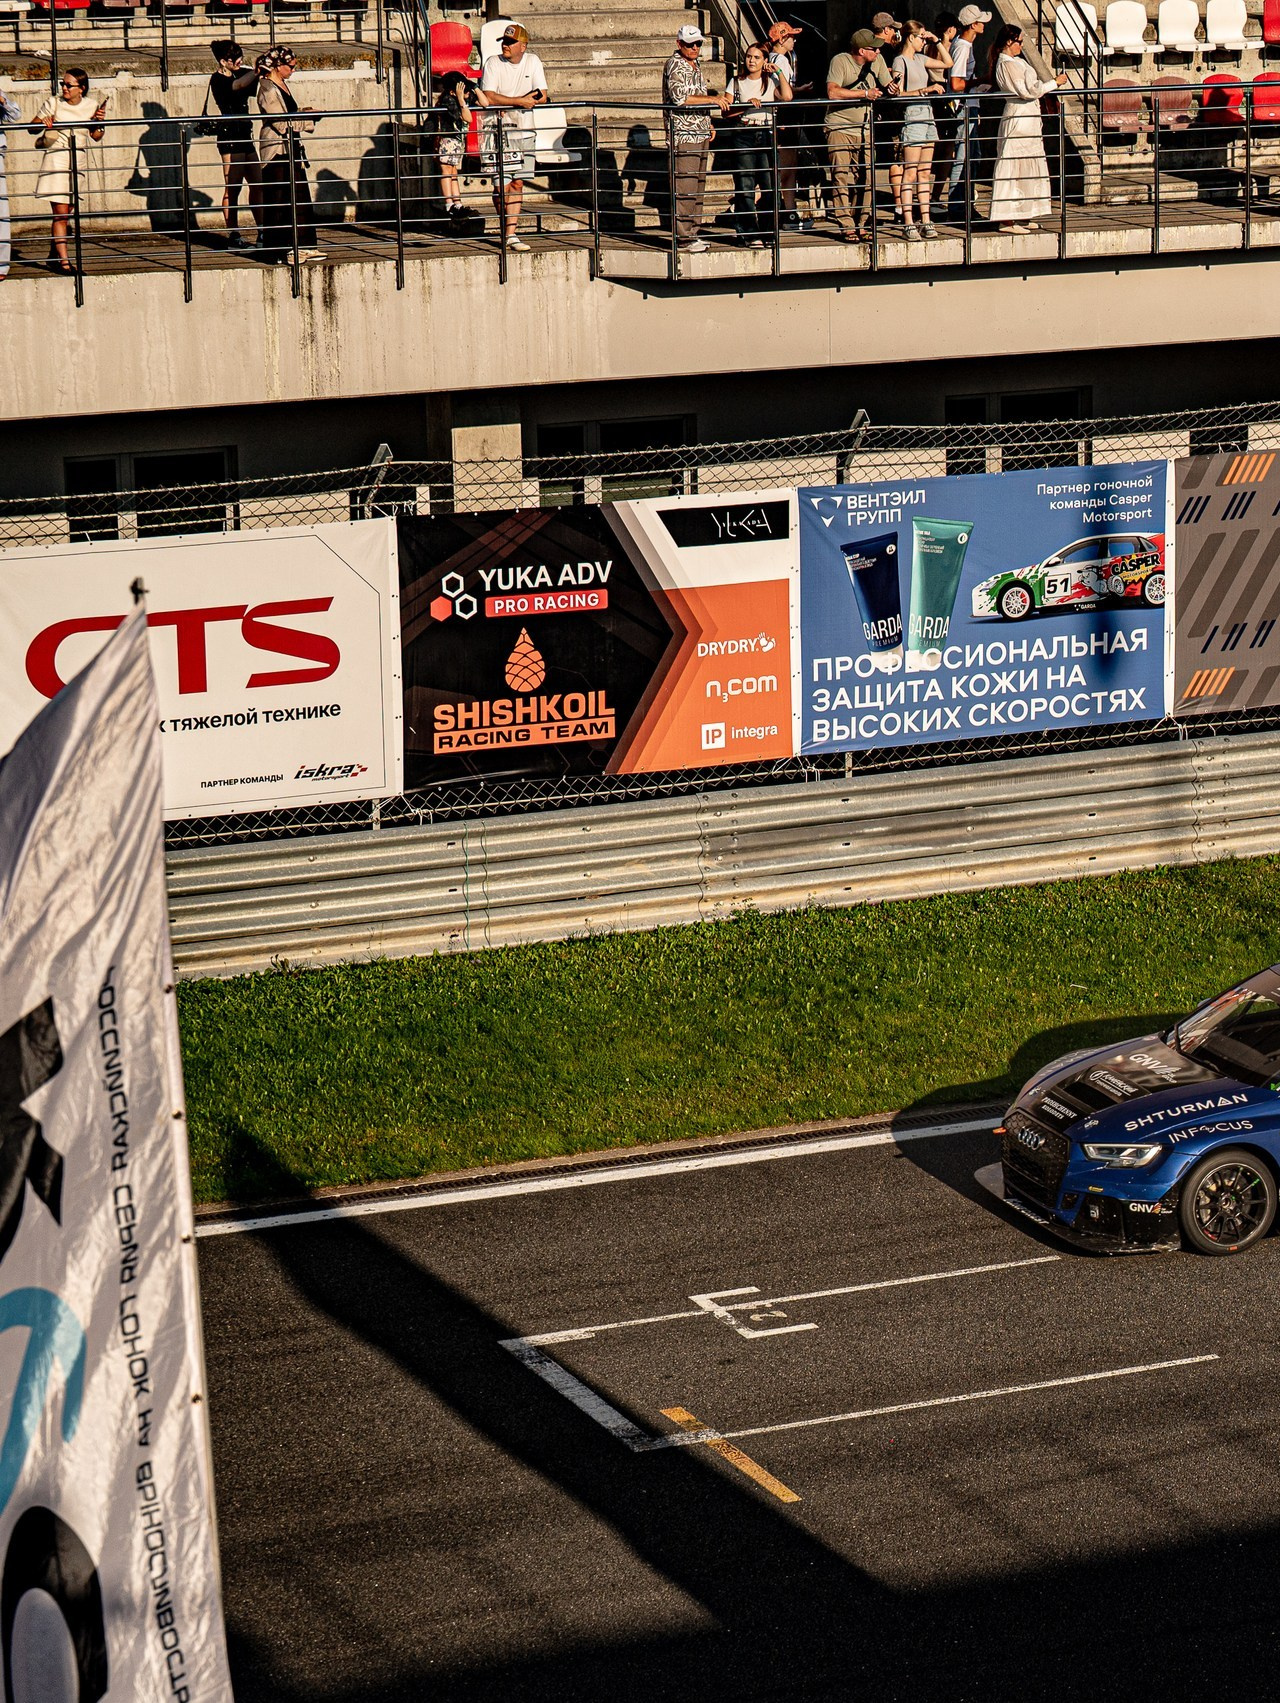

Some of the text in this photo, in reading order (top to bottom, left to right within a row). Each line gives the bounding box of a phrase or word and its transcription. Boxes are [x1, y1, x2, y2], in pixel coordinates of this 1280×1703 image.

[1037, 475, 1153, 497] Партнер гоночной
[847, 490, 926, 510] ВЕНТЭИЛ
[1050, 493, 1153, 510] команды Casper
[847, 508, 902, 527] ГРУПП
[1082, 508, 1153, 523] Motorsport
[1111, 553, 1161, 576] CASPER
[478, 560, 613, 592] YUKA ADV
[1046, 577, 1070, 595] 51
[494, 592, 600, 614] PRO RACING
[863, 613, 903, 641] GARDA
[909, 615, 950, 639] GARDA
[813, 664, 1087, 713] ЗАЩИТА КОЖИ НА
[170, 708, 258, 732] тяжелой
[262, 703, 342, 722] технике
[433, 690, 616, 731] SHISHKOIL
[813, 687, 1147, 743] ВЫСОКИХ СКОРОСТЯХ
[438, 721, 610, 750] RACING TEAM
[731, 725, 778, 739] integra
[200, 774, 284, 788] ПАРТНЕР КОМАНДЫ
[294, 763, 356, 780] iskra
[1124, 1093, 1249, 1131] SHTURMAN
[1129, 1202, 1154, 1214] GNV
